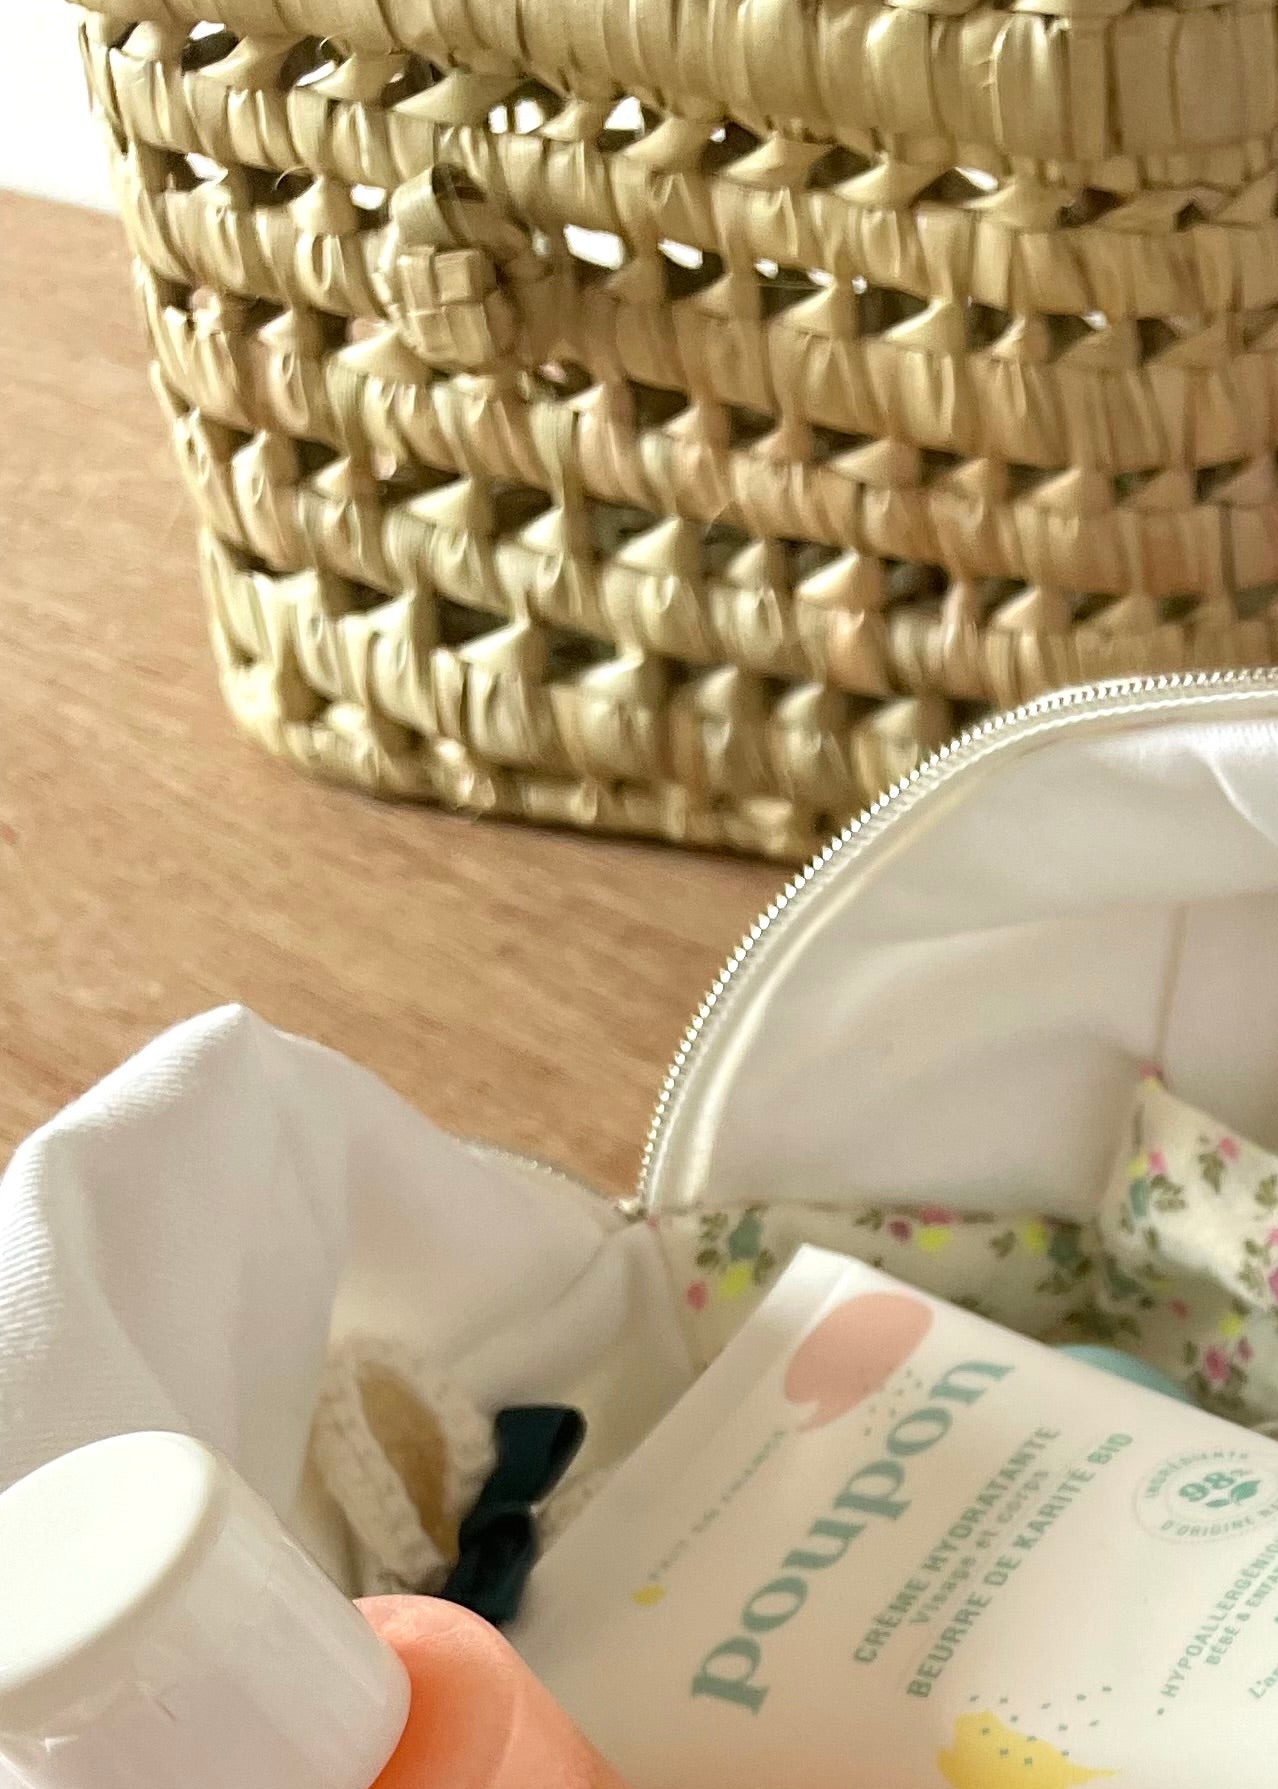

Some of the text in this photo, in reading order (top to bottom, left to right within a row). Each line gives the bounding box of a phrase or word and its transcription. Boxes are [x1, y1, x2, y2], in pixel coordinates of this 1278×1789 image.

[691, 1361, 1015, 1717] poupon
[907, 1592, 993, 1698] BEURRE
[983, 1555, 1022, 1586] DE
[1087, 1433, 1133, 1464] BIO
[921, 1426, 1061, 1573] HYDRATANTE
